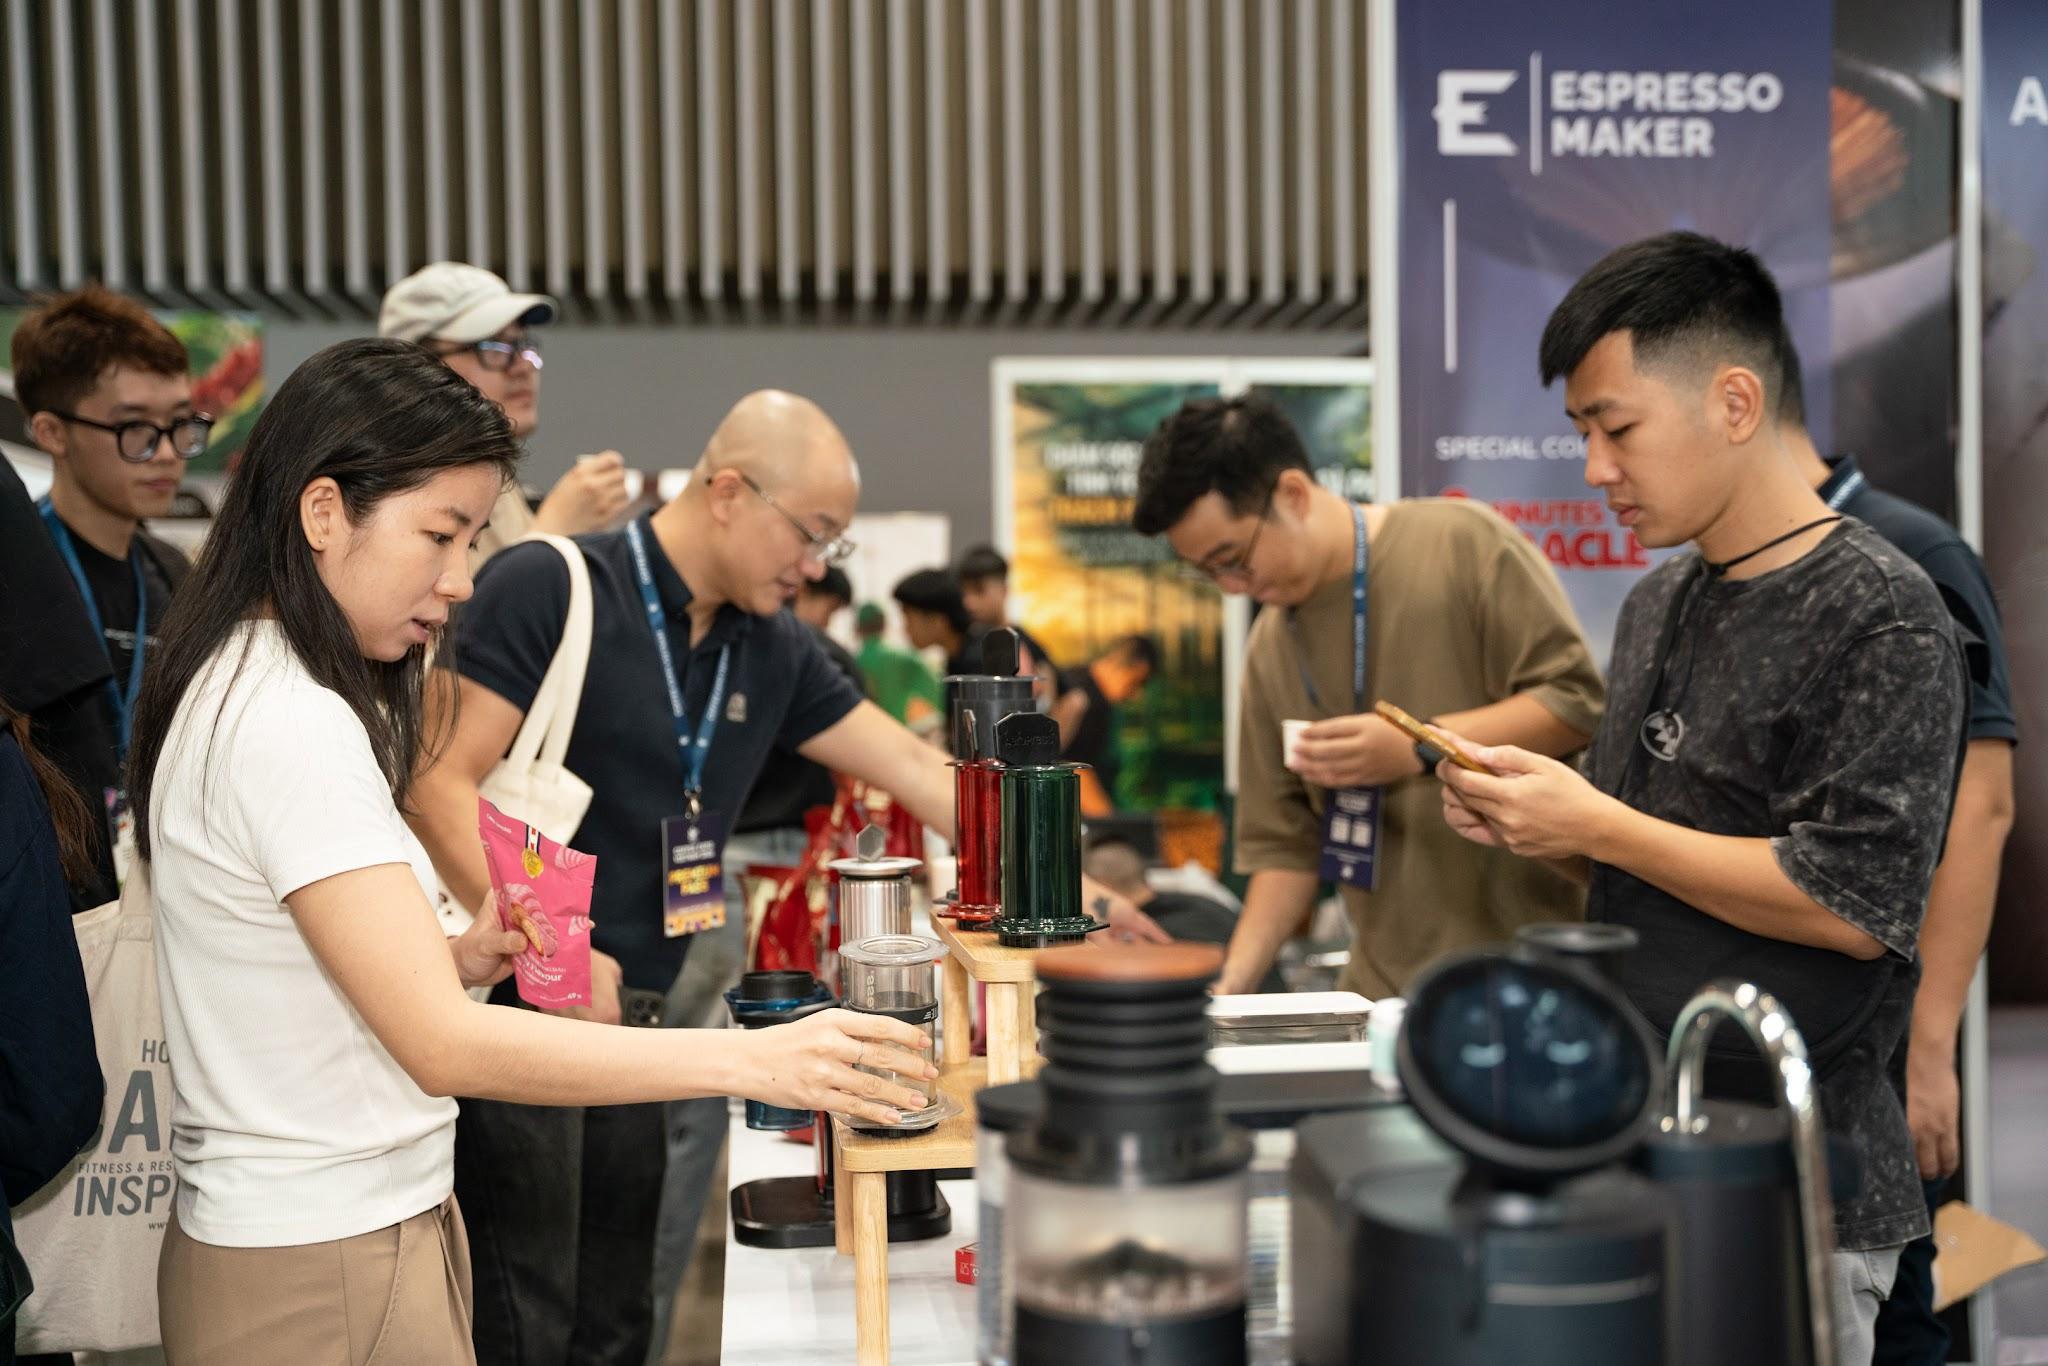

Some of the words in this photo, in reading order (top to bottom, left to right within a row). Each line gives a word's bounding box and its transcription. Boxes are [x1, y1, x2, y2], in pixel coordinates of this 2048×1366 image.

[1551, 70, 1783, 113] ESPRESSO
[1551, 116, 1716, 157] MAKER
[1436, 435, 1538, 460] SPECIAL
[1526, 528, 1650, 568] ACLE
[78, 1162, 132, 1174] FITNESS
[137, 1162, 144, 1173] &
[73, 1174, 173, 1217] INSP
